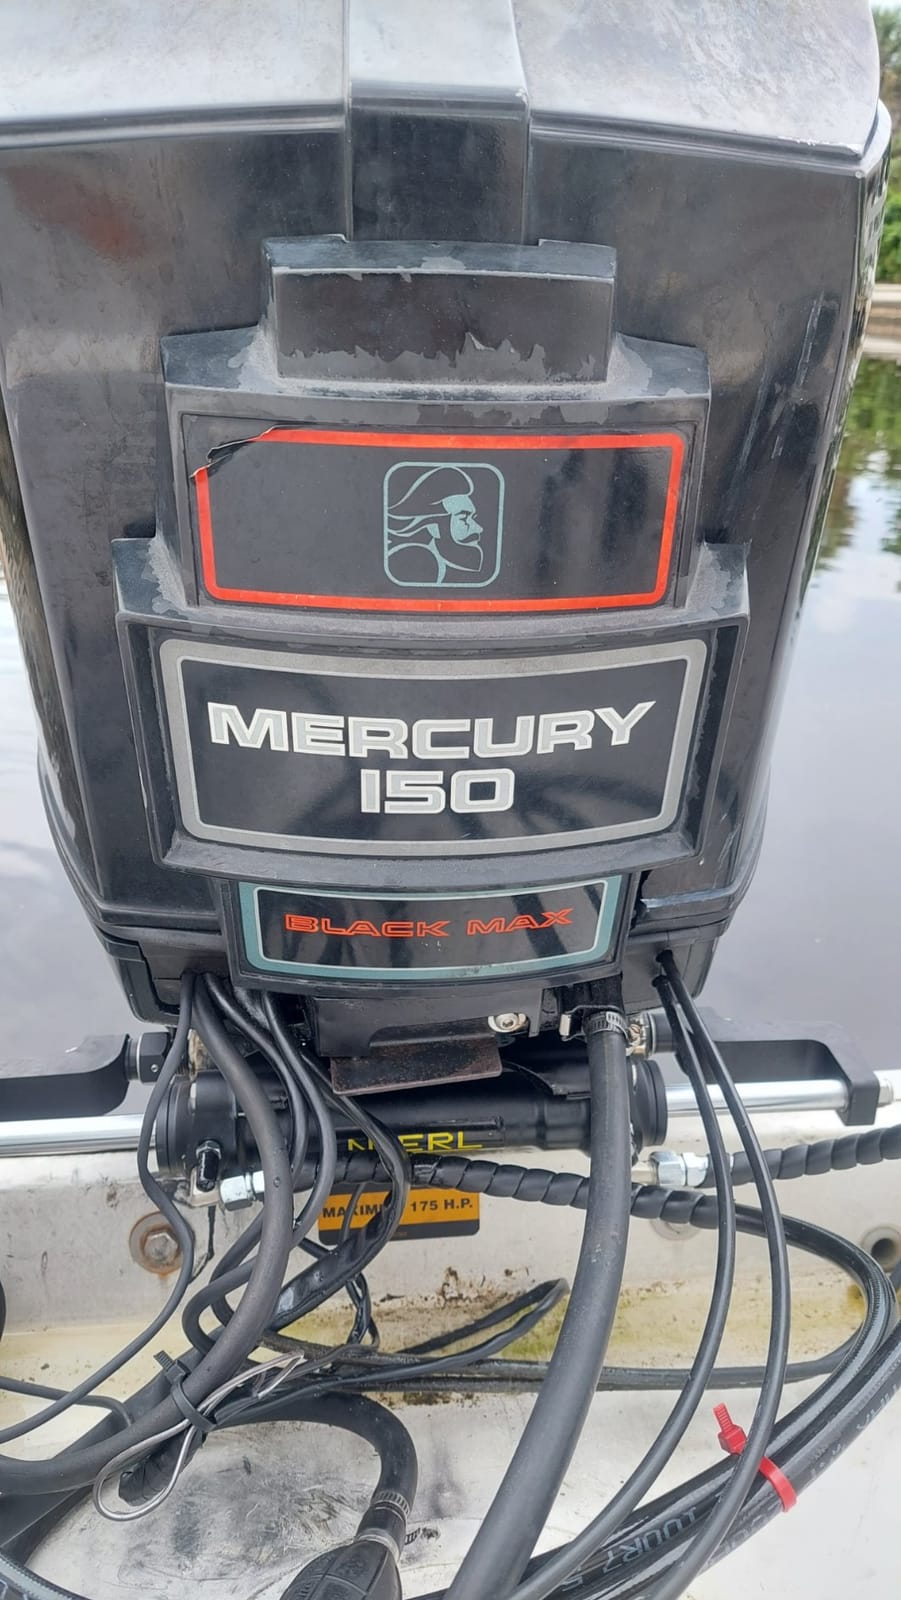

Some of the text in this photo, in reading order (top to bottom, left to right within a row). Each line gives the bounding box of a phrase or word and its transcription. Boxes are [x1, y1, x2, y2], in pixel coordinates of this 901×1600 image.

[207, 700, 656, 760] MERCURY
[360, 767, 516, 814] 150
[284, 907, 575, 938] BLACK MAX
[410, 1200, 439, 1213] 175
[444, 1198, 474, 1211] H.P.
